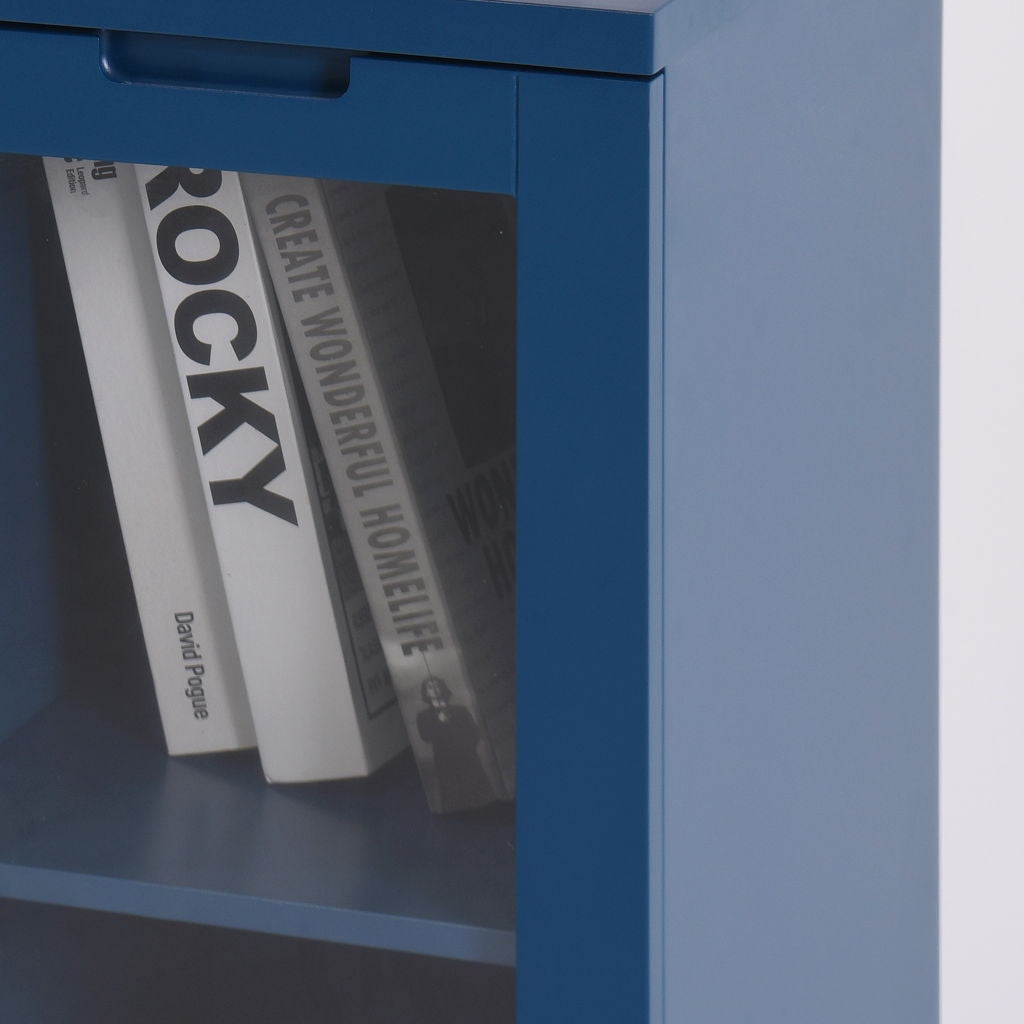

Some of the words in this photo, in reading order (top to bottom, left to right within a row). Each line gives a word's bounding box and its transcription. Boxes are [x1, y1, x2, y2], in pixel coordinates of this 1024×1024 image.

[265, 193, 336, 304] CREATE
[300, 305, 395, 499] WONDERFUL
[359, 502, 444, 657] HOMELIFE
[174, 611, 202, 660] David
[184, 664, 209, 720] Pogue
